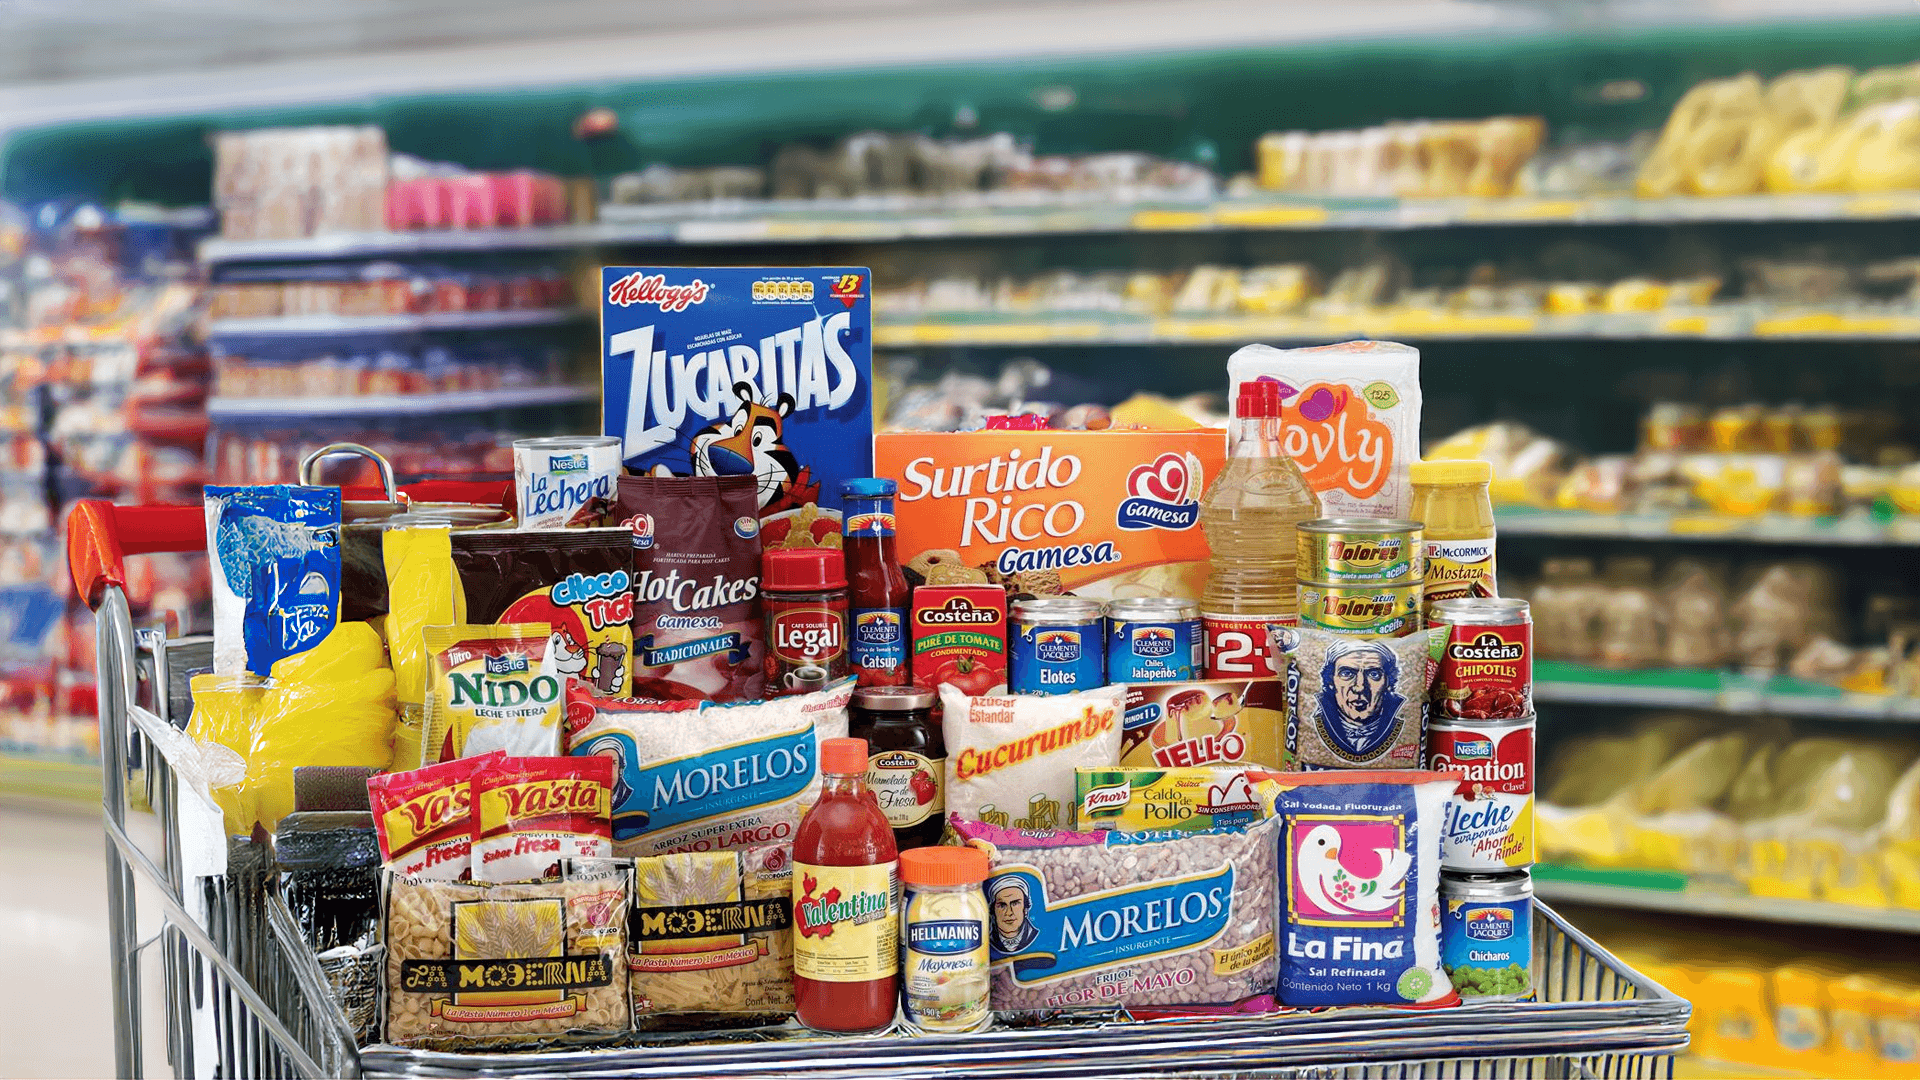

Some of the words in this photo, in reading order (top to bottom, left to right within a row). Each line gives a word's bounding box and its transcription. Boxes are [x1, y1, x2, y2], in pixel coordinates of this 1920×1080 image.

[610, 272, 707, 310] Kellogg's
[838, 274, 860, 293] 13
[610, 312, 857, 460] ZUCARITAS
[900, 445, 1082, 502] Surtido
[532, 472, 548, 493] La
[526, 475, 611, 517] Lechera
[1126, 501, 1191, 525] Gamesa
[960, 497, 1084, 547] Rico
[998, 541, 1114, 575] Gamesa
[1329, 541, 1400, 560] Dolores
[1443, 547, 1488, 557] McCORMICK
[1386, 562, 1409, 578] aceite
[1431, 565, 1483, 580] Mostaza
[552, 570, 630, 605] CHOCO
[952, 600, 968, 610] La
[1324, 596, 1394, 616] Dolores
[657, 615, 719, 629] Gamesa
[923, 610, 993, 622] Costeña
[1220, 622, 1252, 630] VEGETAL
[1380, 618, 1403, 634] aceite
[778, 622, 838, 656] Legal
[864, 632, 896, 642] JACQUES
[918, 635, 942, 651] PURÉ
[944, 635, 958, 644] DE
[960, 634, 1001, 650] TOMATE
[1482, 636, 1498, 646] La
[650, 635, 734, 664] TRADICIONALES
[930, 648, 988, 658] CONDIMENTADO
[1040, 644, 1078, 652] CLEMENTE
[1043, 651, 1076, 659] JACQUES
[1139, 646, 1170, 654] JACQUES
[1454, 646, 1518, 658] Costeña
[862, 654, 898, 670] Catsup
[1040, 669, 1076, 684] Elotes
[1132, 666, 1177, 680] Jalapeños
[1456, 664, 1516, 678] CHIPOTLES
[449, 673, 559, 707] NIDO
[475, 708, 504, 718] LECHE
[506, 706, 547, 718] ENTERA
[1287, 658, 1299, 750] MORELOS
[1145, 708, 1148, 719] 1
[1150, 707, 1156, 718] L
[652, 744, 808, 811] MORELOS
[900, 786, 909, 796] de
[1143, 788, 1182, 800] Caldo
[1503, 782, 1525, 792] Clavel
[499, 781, 599, 818] Ya'stá
[705, 792, 758, 811] INSURGENTE
[879, 790, 916, 809] Fresa
[1086, 789, 1128, 808] Knorr
[1180, 797, 1192, 806] de
[1284, 800, 1300, 808] Sal
[1302, 802, 1342, 811] Yodada
[1344, 803, 1402, 812] Fluorurada
[1144, 802, 1192, 820] Pollo
[1198, 806, 1210, 814] SIN
[1210, 804, 1262, 814] CONSERVADORES
[1448, 801, 1514, 837] Leche
[653, 834, 688, 851] ARROZ
[691, 824, 725, 840] SUPER
[729, 817, 762, 830] EXTRA
[718, 822, 791, 849] LARGO
[1454, 822, 1509, 845] evaporada
[483, 848, 512, 864] Sabor
[514, 838, 561, 856] Fresa
[1472, 833, 1515, 858] ¡Ahorra
[1488, 853, 1493, 861] y
[1494, 836, 1525, 861] Rinde!
[802, 891, 886, 927] Valentina
[641, 903, 786, 936] MODERNA
[1058, 887, 1224, 952] MORELOS
[1470, 922, 1510, 930] CLEMENTE
[911, 925, 979, 942] HELLMANN'S
[1474, 928, 1508, 937] JACQUES
[1115, 935, 1172, 955] INSURGENTE
[1288, 932, 1326, 960] La
[1332, 936, 1404, 960] Fina
[632, 955, 642, 964] La
[644, 956, 668, 968] Pasta
[669, 954, 704, 968] Número
[705, 956, 710, 964] 1
[712, 955, 724, 963] en
[725, 948, 754, 962] México
[1220, 953, 1229, 964] El
[1469, 950, 1510, 962] Chícharos
[918, 958, 973, 974] Mayonesa
[1230, 961, 1240, 970] de
[1309, 967, 1326, 976] Sal
[1331, 968, 1386, 976] Refinada
[406, 964, 448, 989] LA
[458, 960, 608, 988] MODERNA
[1096, 970, 1134, 986] FRIJOL
[1046, 984, 1097, 1008] FLOR
[1100, 980, 1128, 998] DE
[1132, 967, 1195, 993] MAYO
[1282, 978, 1334, 991] Contenido
[1337, 982, 1362, 991] Neto
[1366, 982, 1372, 990] 1
[1377, 982, 1391, 992] kg
[446, 1008, 458, 1017] La
[460, 1008, 484, 1018] Pasta
[486, 1008, 520, 1018] Número
[522, 1010, 528, 1018] 1
[530, 1008, 542, 1016] en
[544, 1003, 573, 1016] México
[923, 1007, 934, 1016] 190
